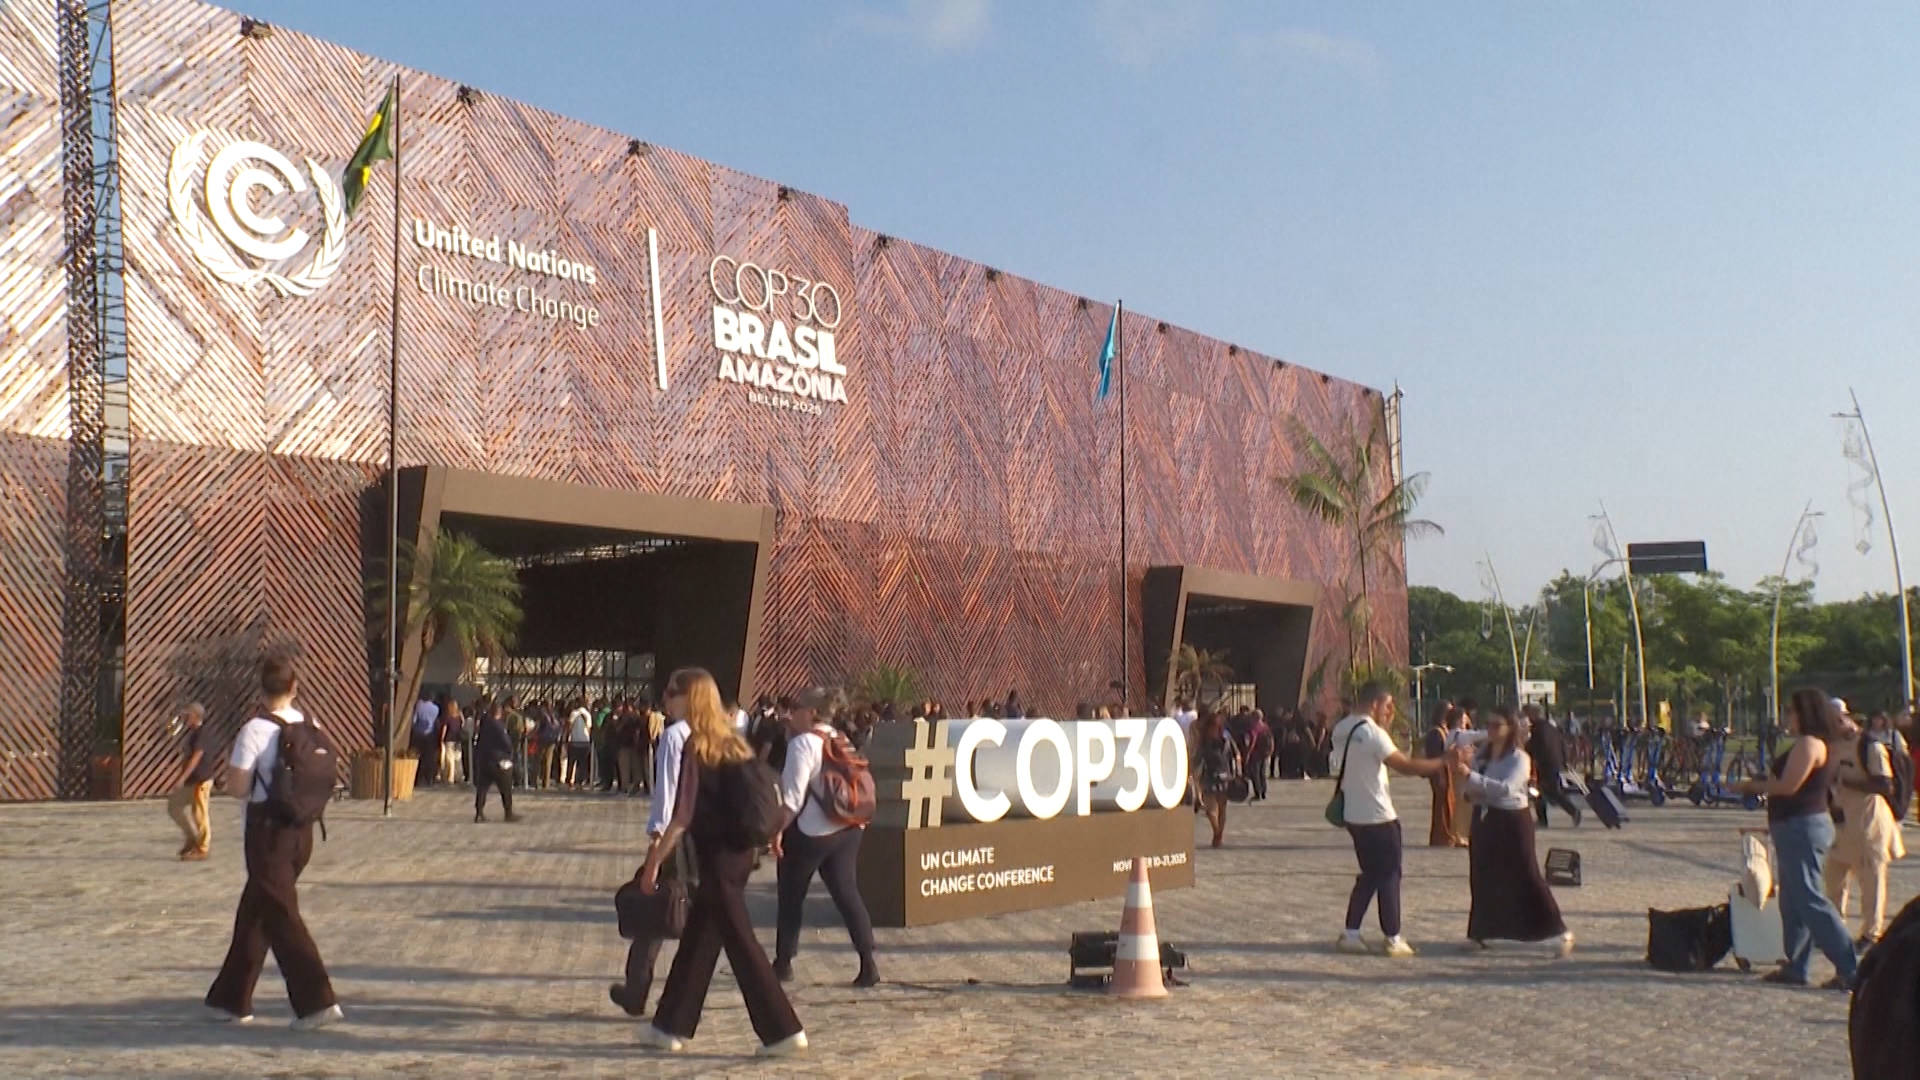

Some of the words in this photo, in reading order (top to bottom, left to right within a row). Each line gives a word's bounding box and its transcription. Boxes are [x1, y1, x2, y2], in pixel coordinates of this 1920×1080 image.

[415, 218, 500, 263] United
[508, 240, 597, 285] Nations
[418, 264, 510, 308] Climate
[516, 285, 600, 331] Change
[710, 255, 841, 328] COP30
[713, 304, 847, 377] BRASIL
[902, 717, 1189, 830] #COP30
[921, 852, 940, 871] UN
[941, 846, 995, 868] CLIMATE
[921, 874, 976, 897] CHANGE
[976, 864, 1055, 890] CONFERENCE
